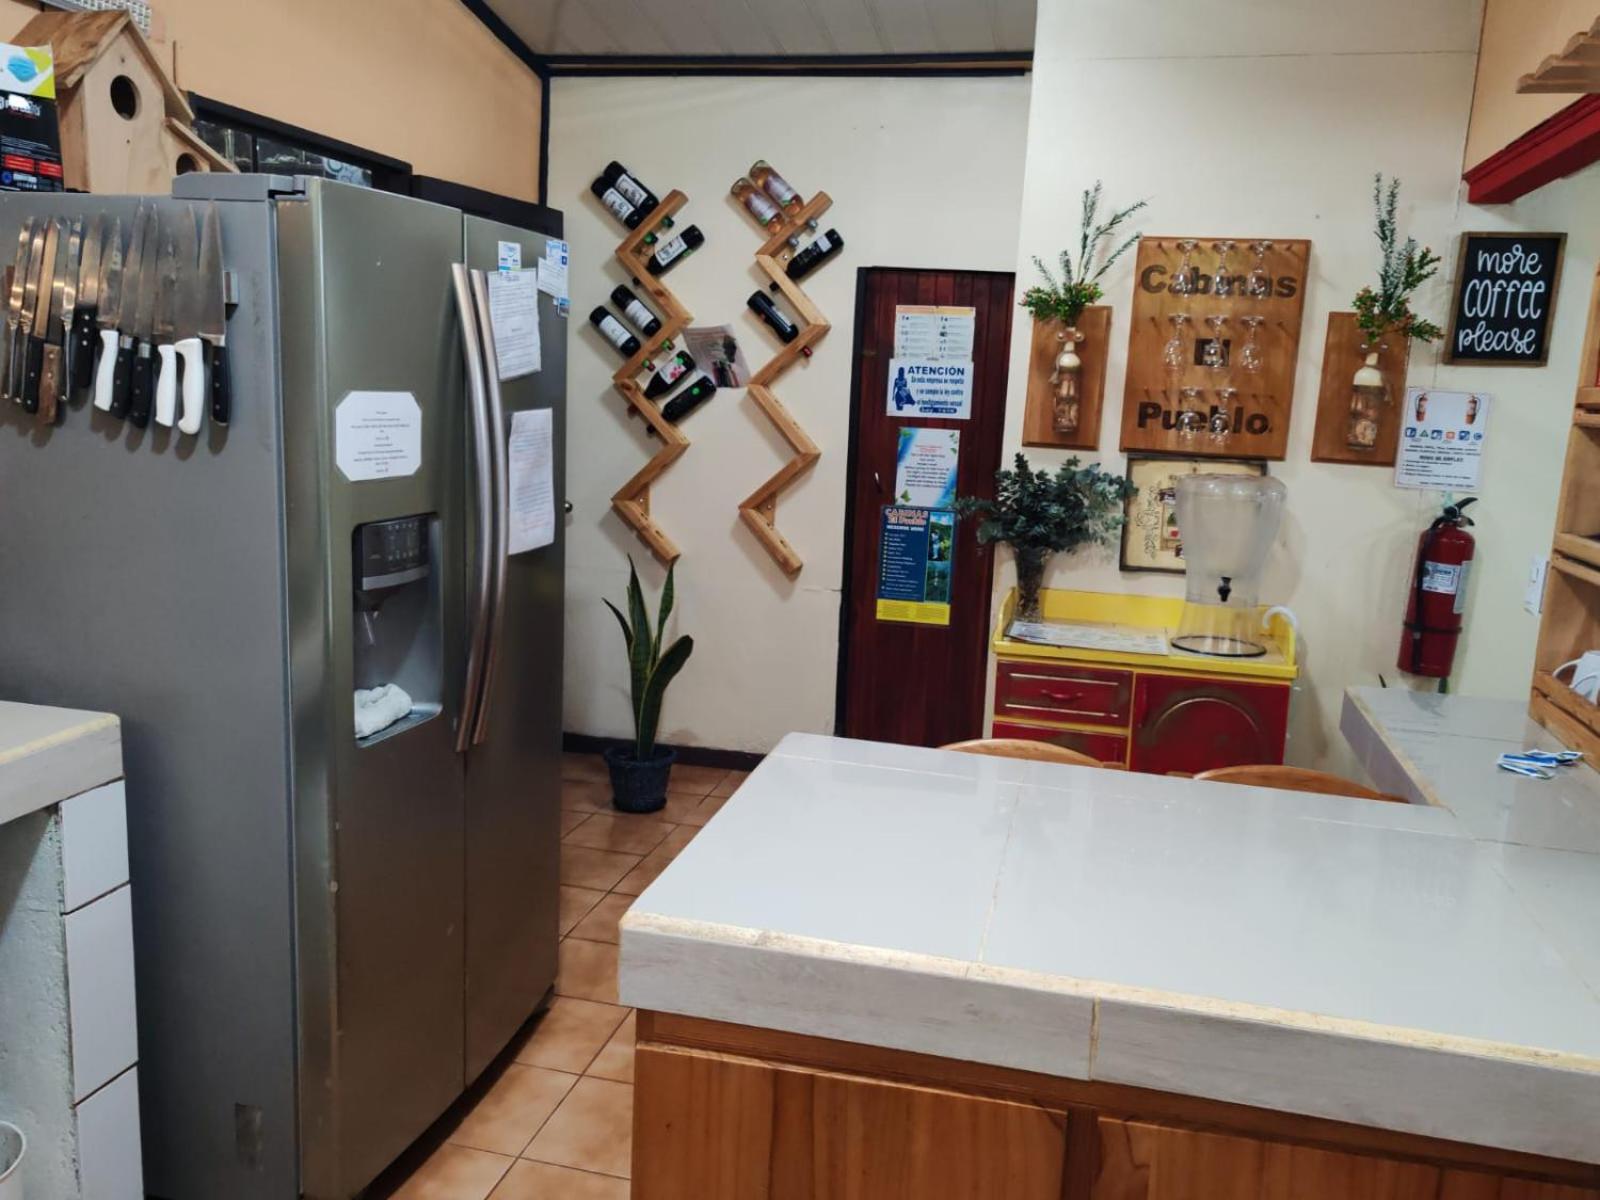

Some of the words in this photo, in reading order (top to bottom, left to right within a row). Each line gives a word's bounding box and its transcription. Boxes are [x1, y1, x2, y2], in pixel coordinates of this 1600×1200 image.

[1478, 244, 1542, 275] more
[1459, 321, 1536, 354] please
[908, 366, 965, 376] ATENCIÓN
